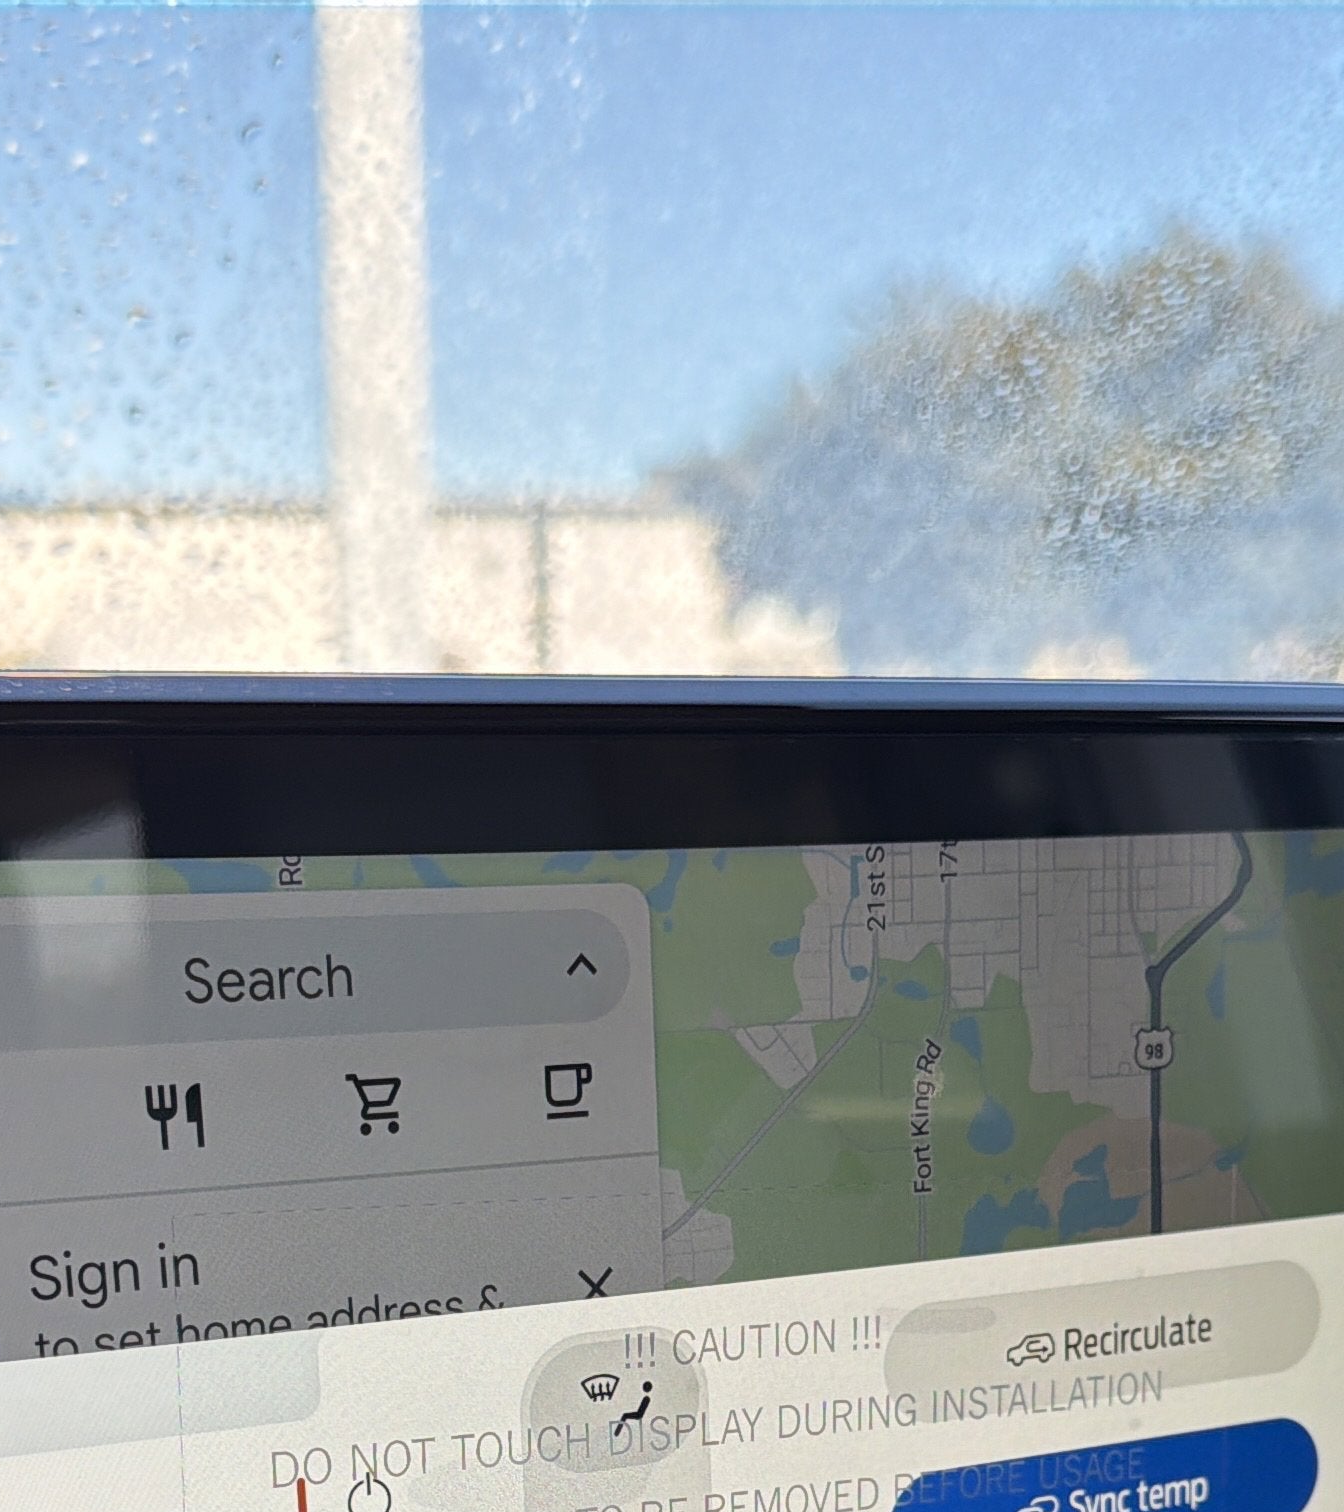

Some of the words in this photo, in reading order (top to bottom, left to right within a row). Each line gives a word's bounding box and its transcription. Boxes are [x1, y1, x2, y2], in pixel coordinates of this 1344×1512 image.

[866, 871, 887, 932] 21st
[183, 954, 355, 1006] Search
[916, 1038, 943, 1075] Rd
[1144, 1043, 1165, 1061] 98
[910, 1079, 936, 1137] King
[913, 1144, 932, 1194] Fort
[29, 1249, 141, 1309] Sign
[157, 1241, 201, 1290] in
[94, 1321, 162, 1350] set
[175, 1313, 293, 1342] home
[306, 1292, 464, 1329] address
[622, 1332, 658, 1371] !!!
[671, 1316, 838, 1367] CAUTION
[851, 1314, 883, 1352] !!!
[1063, 1312, 1214, 1361] Recirculate
[270, 1447, 333, 1489] DO
[351, 1436, 436, 1481] NOT
[450, 1422, 592, 1470] TOUCH
[608, 1406, 765, 1455] DISPLAY
[777, 1392, 918, 1441] DURING
[931, 1369, 1164, 1424] INSTALLATION
[894, 1460, 1026, 1506] BEFORE
[1038, 1445, 1146, 1490] USAGE
